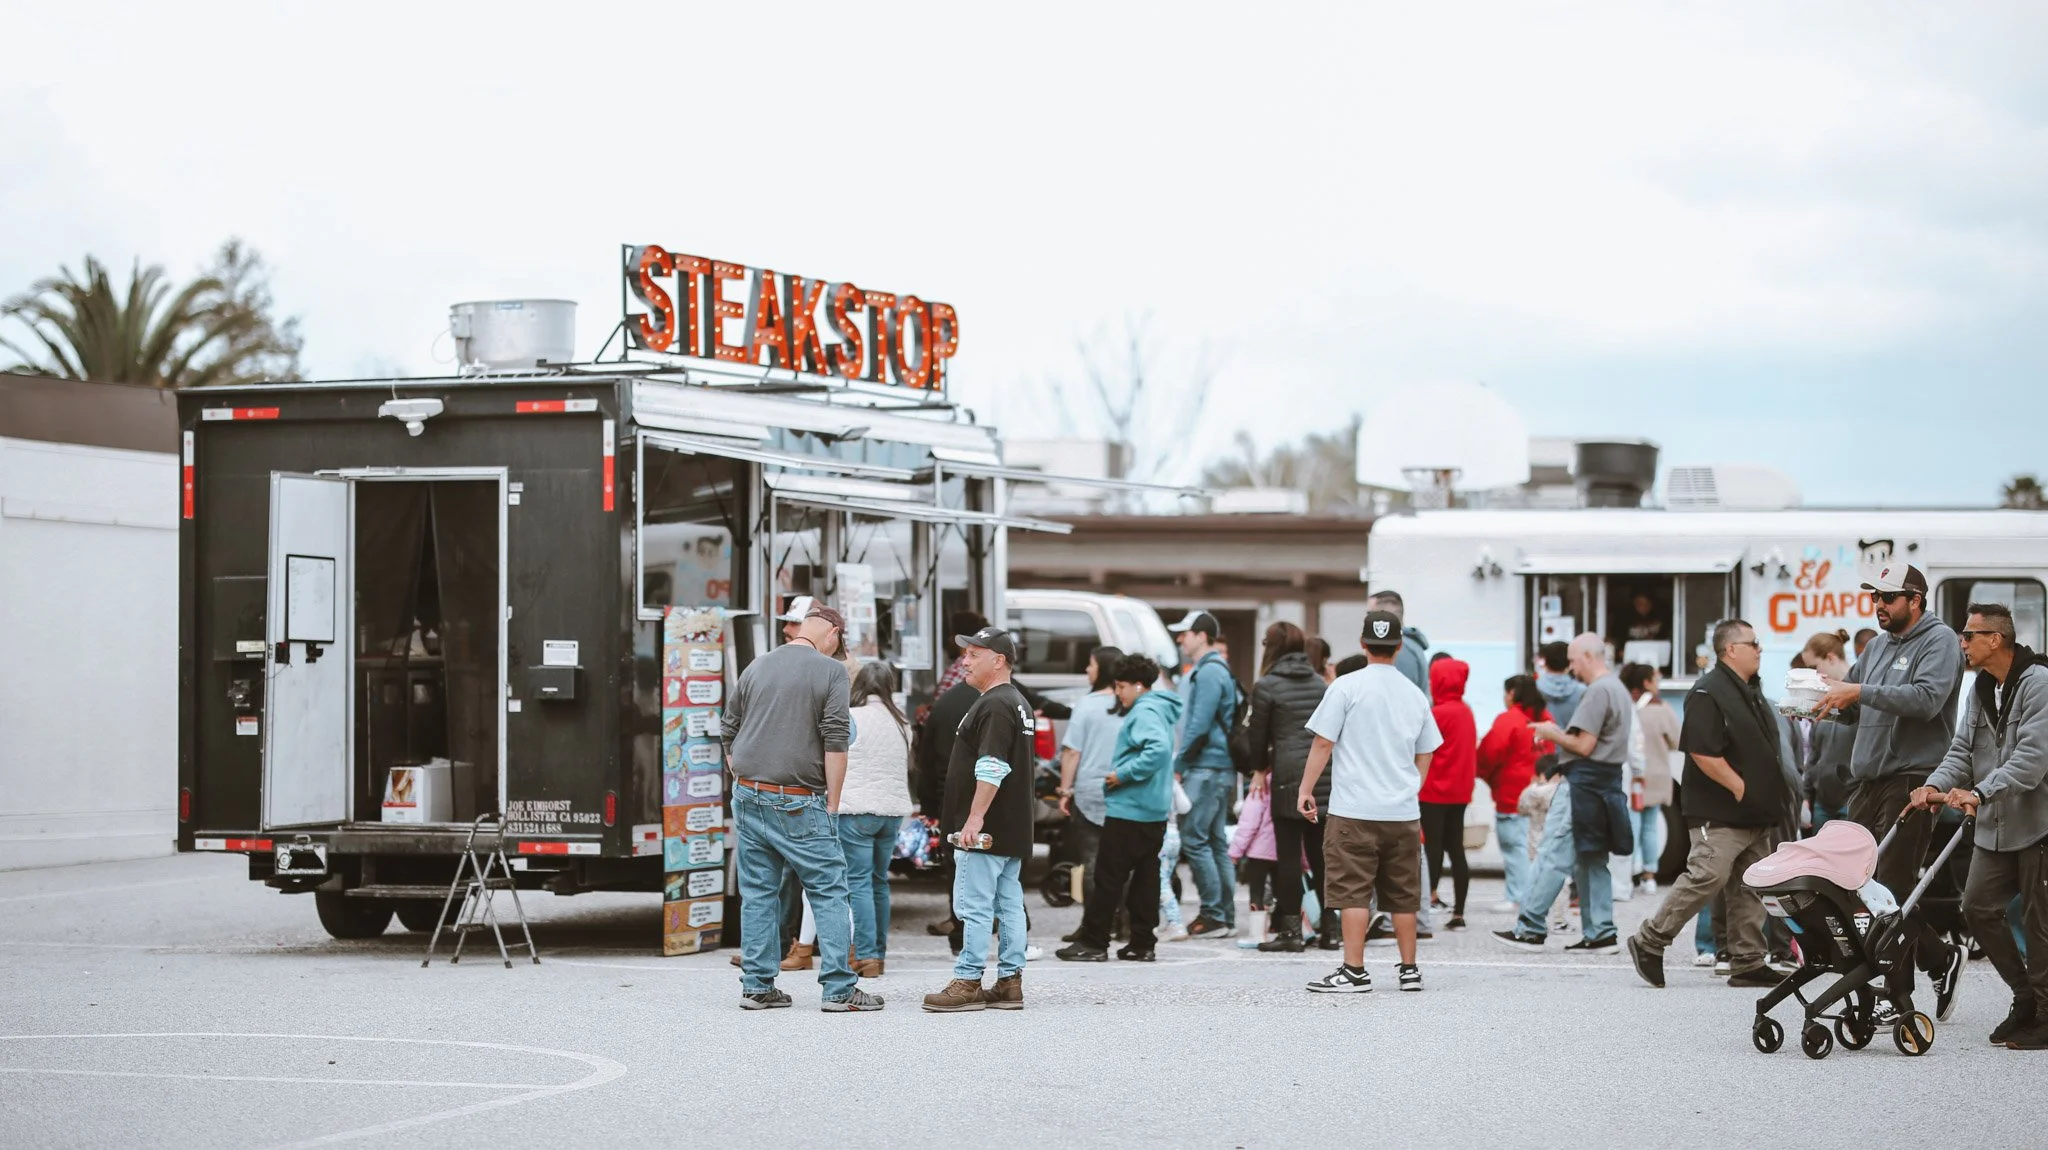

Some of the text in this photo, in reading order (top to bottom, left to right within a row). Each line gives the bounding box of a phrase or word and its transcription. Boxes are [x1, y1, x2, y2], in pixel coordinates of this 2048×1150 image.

[1795, 560, 1832, 590] El
[507, 800, 524, 811] JOE
[506, 811, 601, 824] HOLLISTER CA 95023
